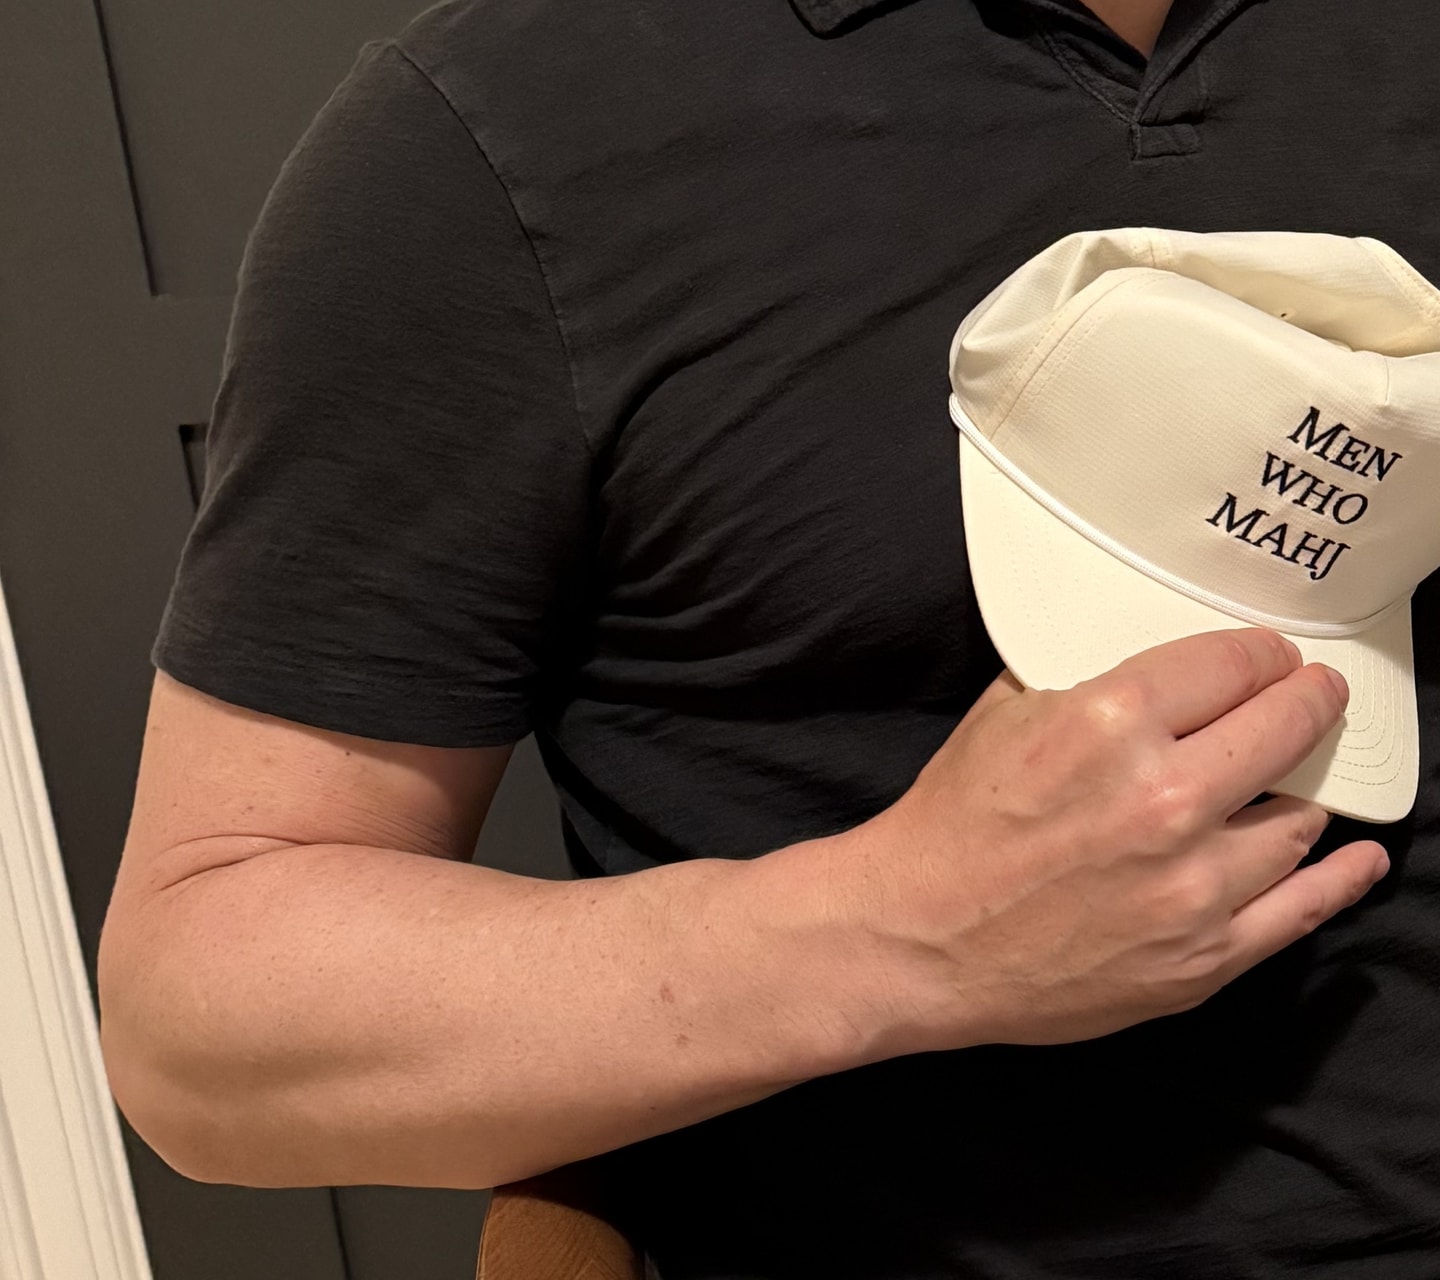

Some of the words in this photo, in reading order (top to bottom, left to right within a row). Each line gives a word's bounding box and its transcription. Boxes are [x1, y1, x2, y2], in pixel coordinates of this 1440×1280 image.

[1286, 406, 1403, 481] MEN
[1261, 451, 1369, 525] WHO
[1205, 492, 1351, 580] MAHJ
